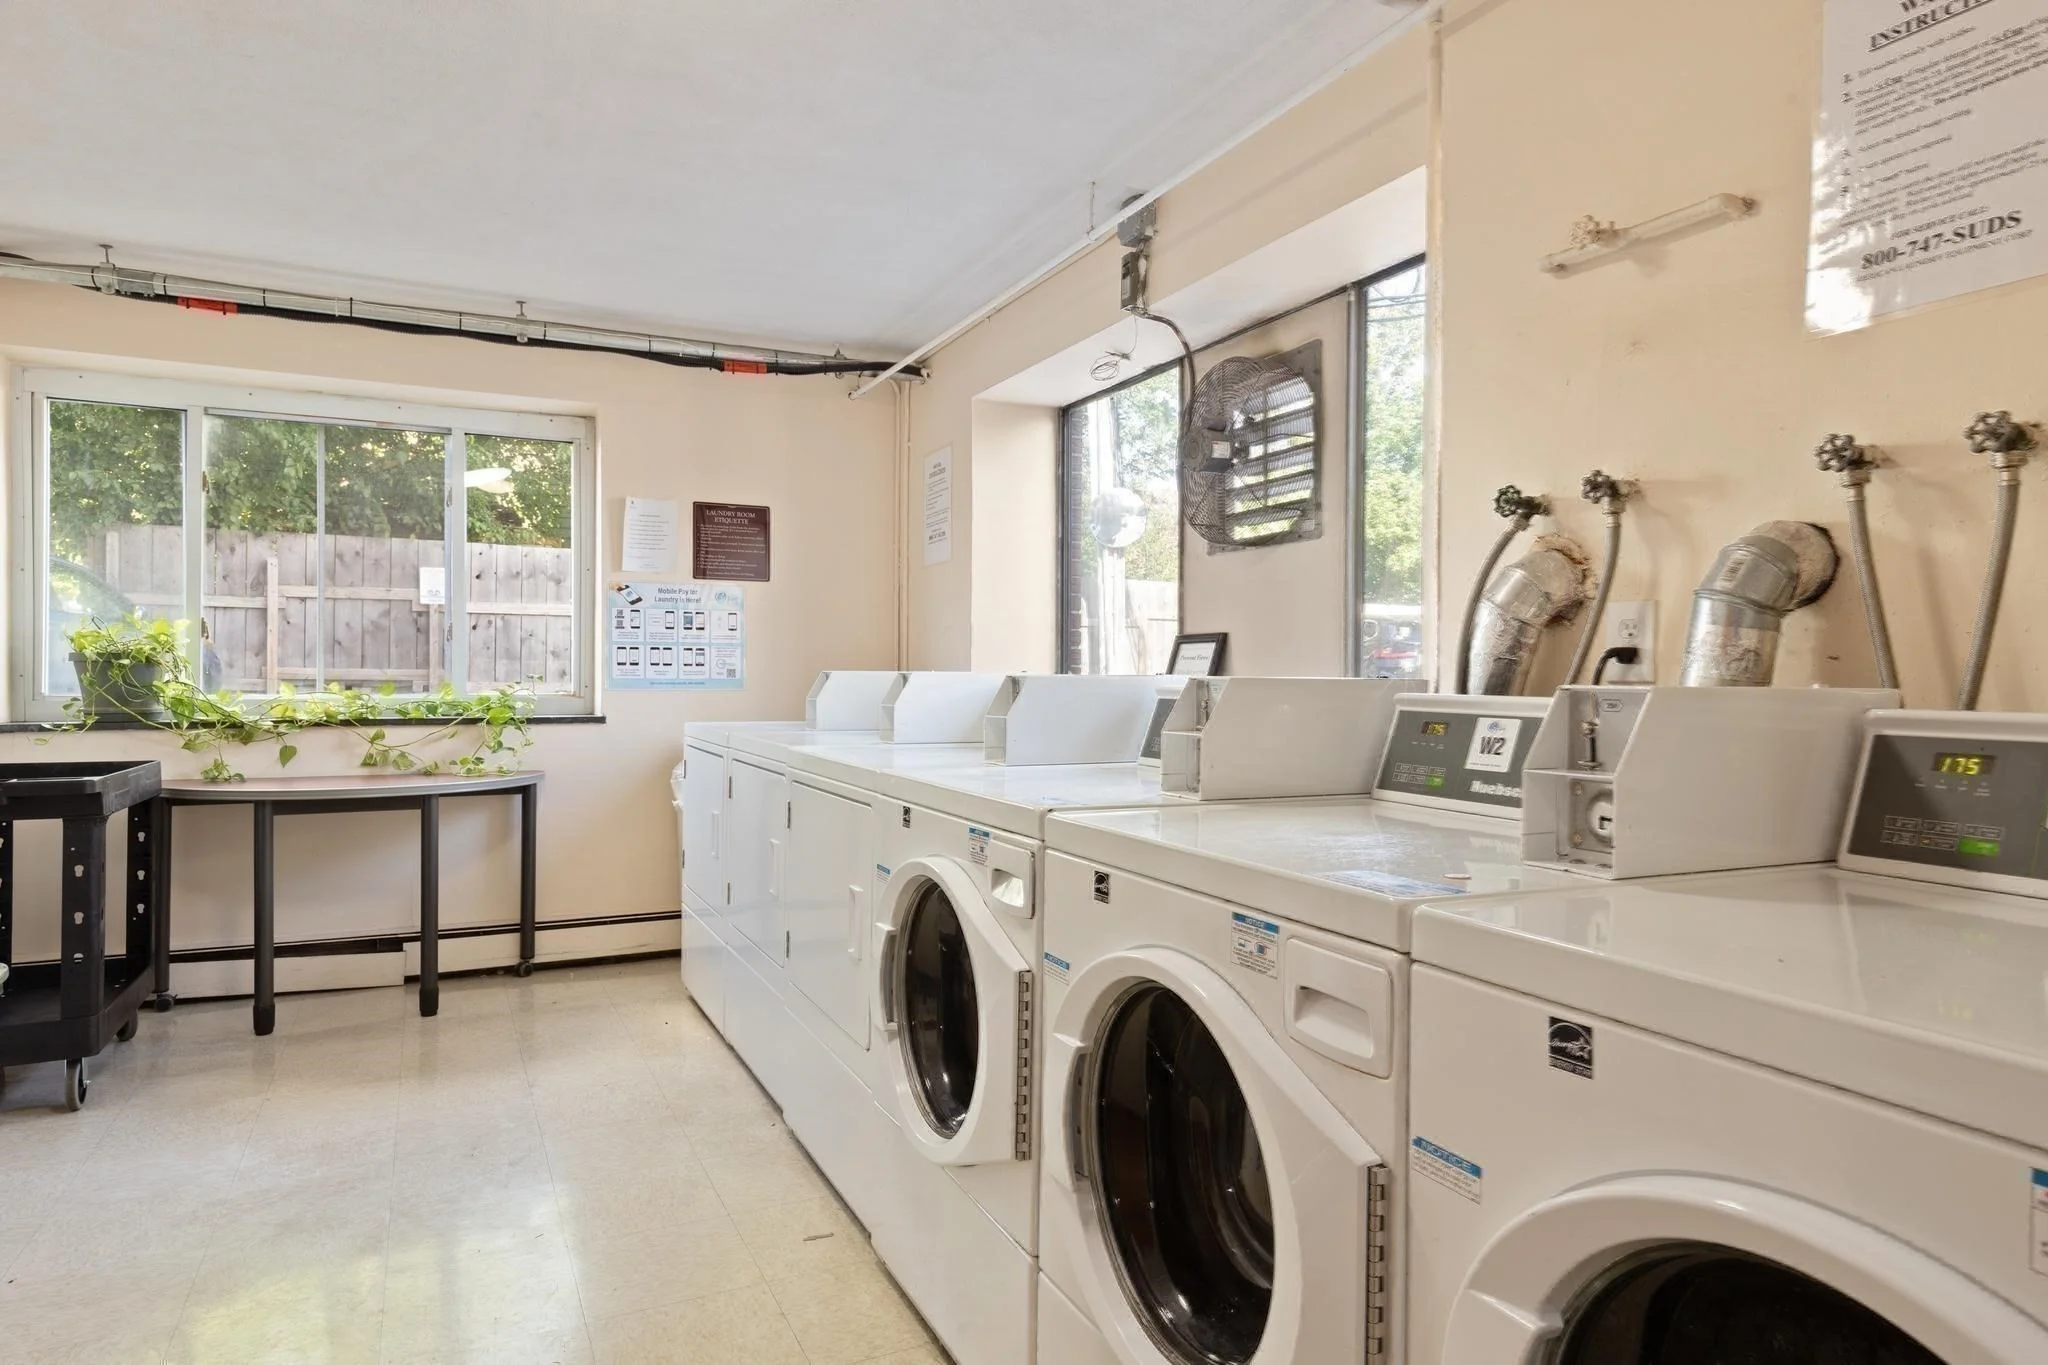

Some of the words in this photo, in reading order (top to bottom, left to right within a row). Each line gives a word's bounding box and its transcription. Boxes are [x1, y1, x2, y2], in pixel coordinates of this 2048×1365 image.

[1869, 0, 1983, 49] INSTRUCT
[1861, 209, 2022, 270] 800-747-SUDS
[706, 509, 736, 517] LAUNDRY
[736, 511, 757, 519] ROOM
[714, 516, 750, 525] ETIQUETTE
[654, 596, 679, 604] Laundry
[658, 587, 678, 595] Mobile
[678, 588, 688, 596] Pay
[1479, 735, 1505, 756] W2
[1940, 757, 1981, 775] 175
[1469, 780, 1522, 798] Huebsc
[1419, 1140, 1473, 1173] NOTICE
